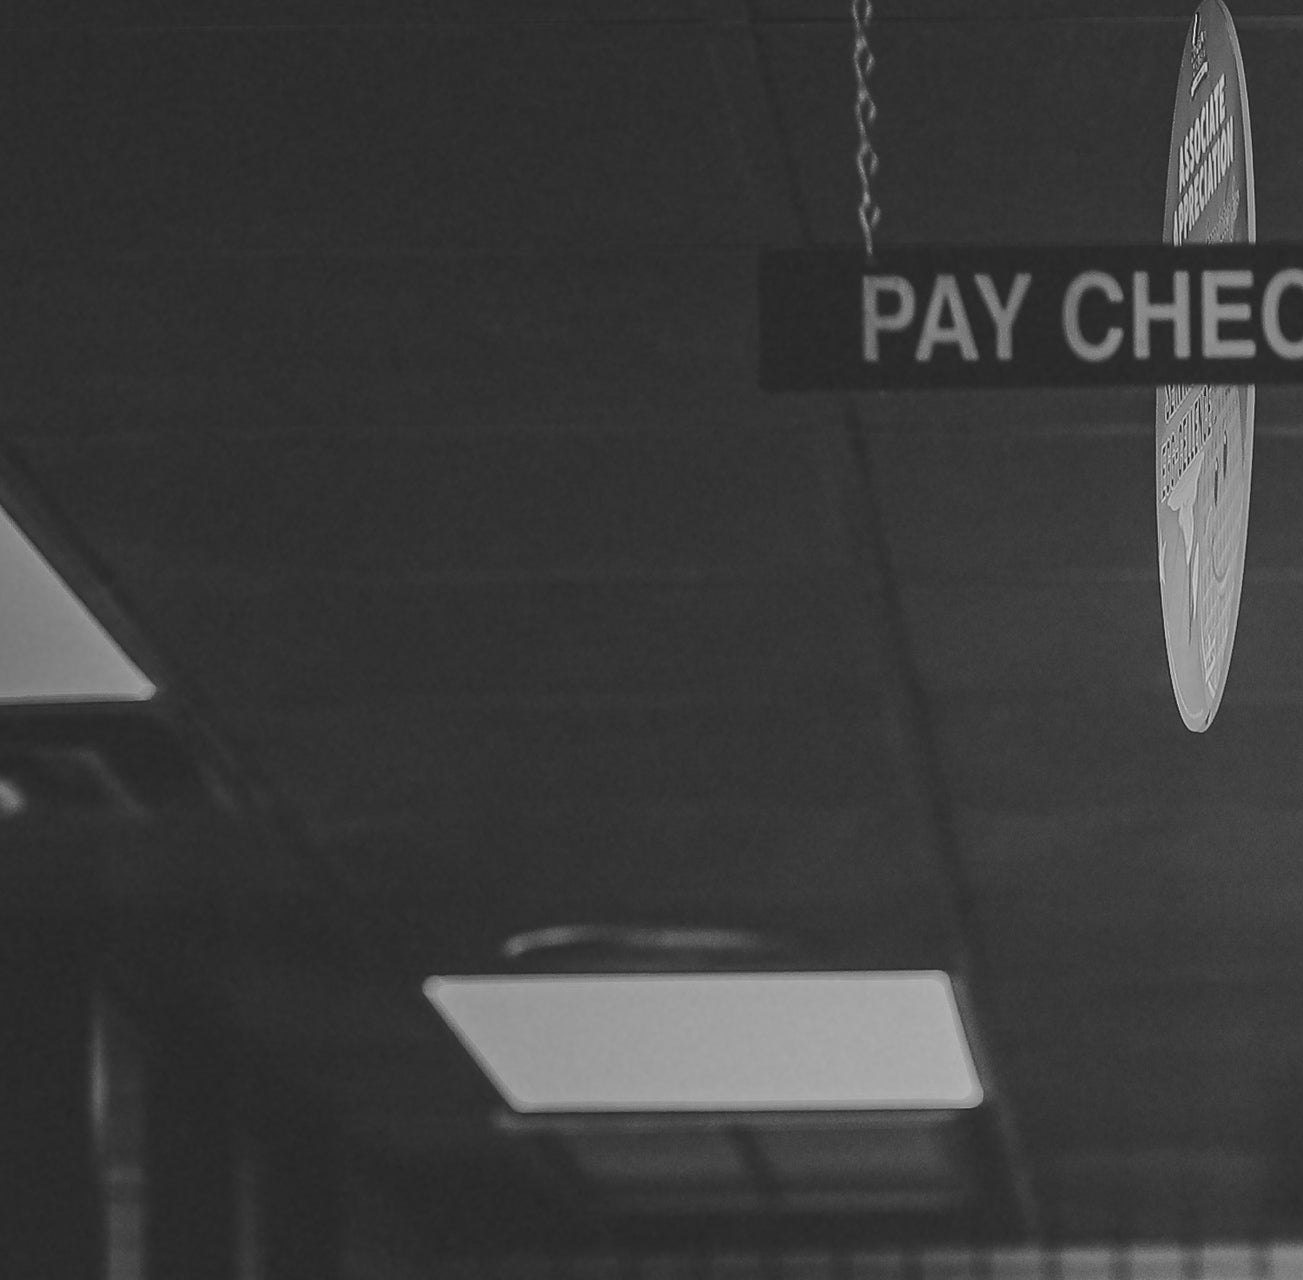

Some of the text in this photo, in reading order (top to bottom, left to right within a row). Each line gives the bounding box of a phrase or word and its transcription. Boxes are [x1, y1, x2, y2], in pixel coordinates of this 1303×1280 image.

[1173, 115, 1234, 247] APPRECIATION
[1178, 73, 1226, 194] ASSOCIATE
[862, 272, 1032, 362] PAY
